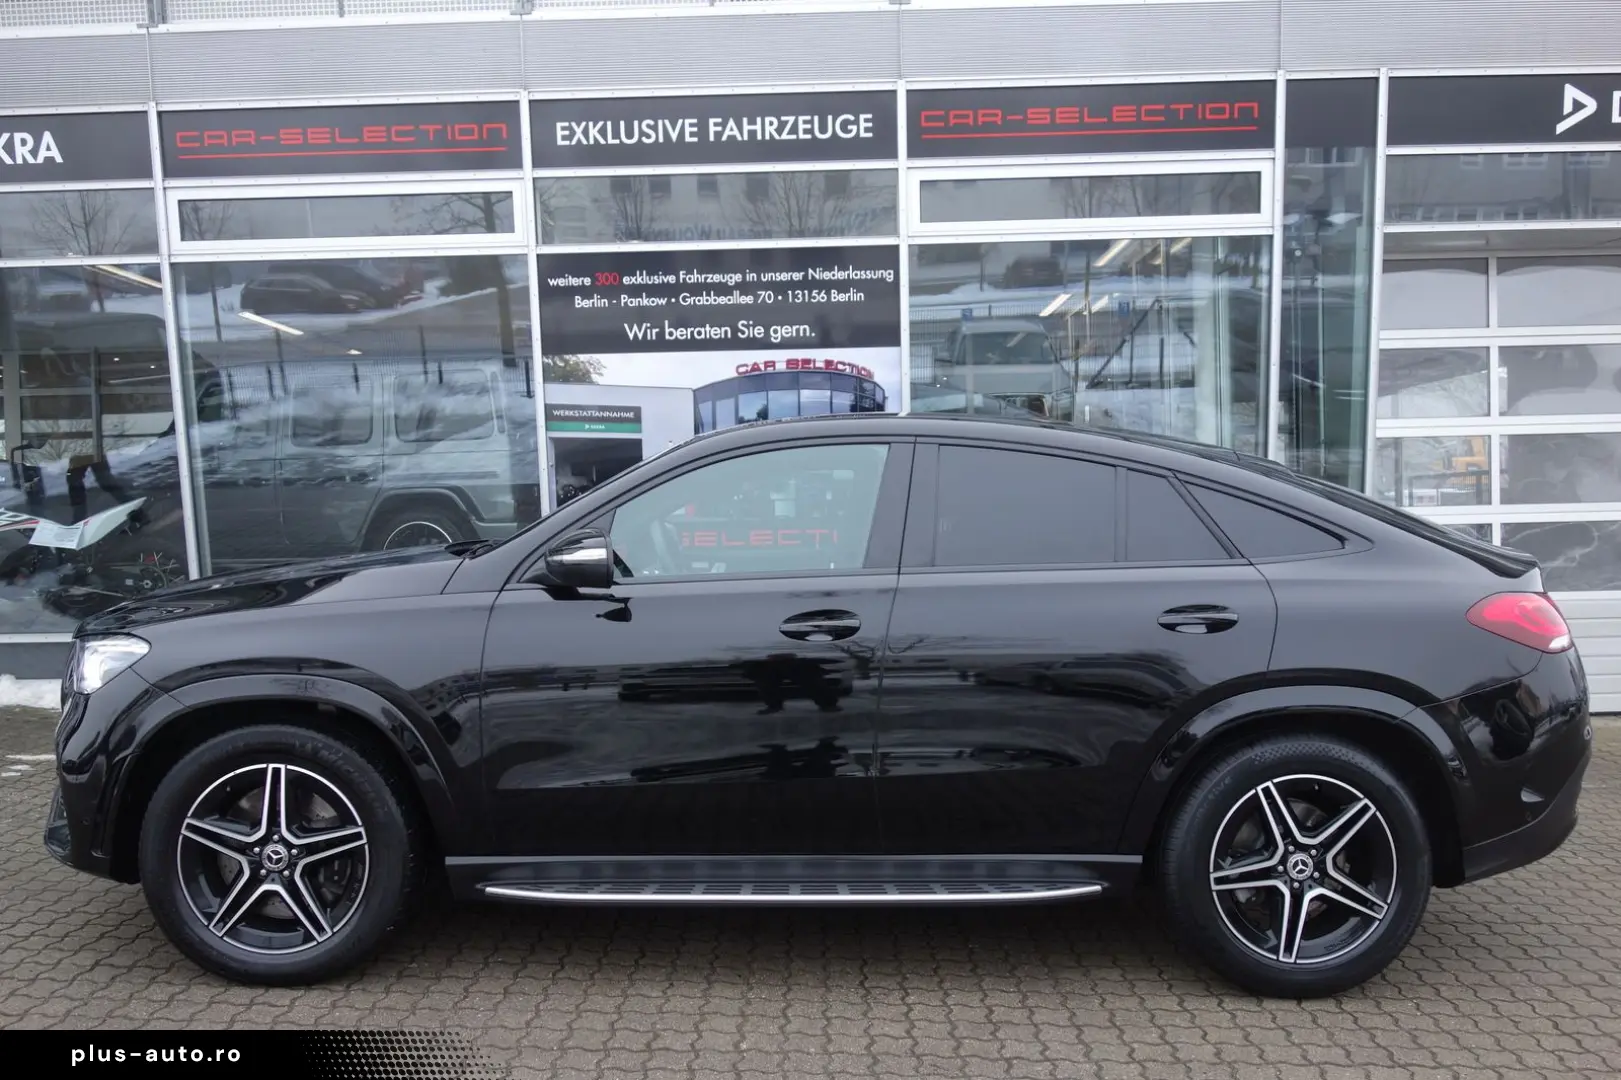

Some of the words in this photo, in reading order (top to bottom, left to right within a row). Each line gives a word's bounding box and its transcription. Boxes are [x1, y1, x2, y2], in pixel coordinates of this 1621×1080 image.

[920, 102, 1259, 128] CAR-SELECTION
[176, 123, 508, 148] CAR-SELECTION
[555, 118, 699, 146] EXKLUSIVE
[708, 113, 874, 142] FAHRZEUGE
[547, 273, 592, 287] weitere
[594, 272, 620, 286] 300
[622, 269, 677, 285] exklusive
[679, 268, 743, 286] Fahrzeuge
[745, 269, 757, 282] in
[761, 270, 805, 282] unserer
[808, 265, 894, 282] Niederlassung
[574, 293, 609, 308] Berlin
[620, 293, 668, 307] Pankow
[679, 290, 754, 305] Grabbeallee
[757, 290, 774, 304] 70
[787, 289, 828, 303] 13156
[831, 287, 865, 302] Berlin
[624, 323, 660, 341] Wir
[665, 319, 732, 340] beraten
[737, 320, 765, 338] Sie
[769, 324, 816, 343] gern.
[735, 360, 776, 376] CAR
[785, 358, 875, 379] SELECTION
[552, 409, 635, 418] WERKSTATTANNAHME
